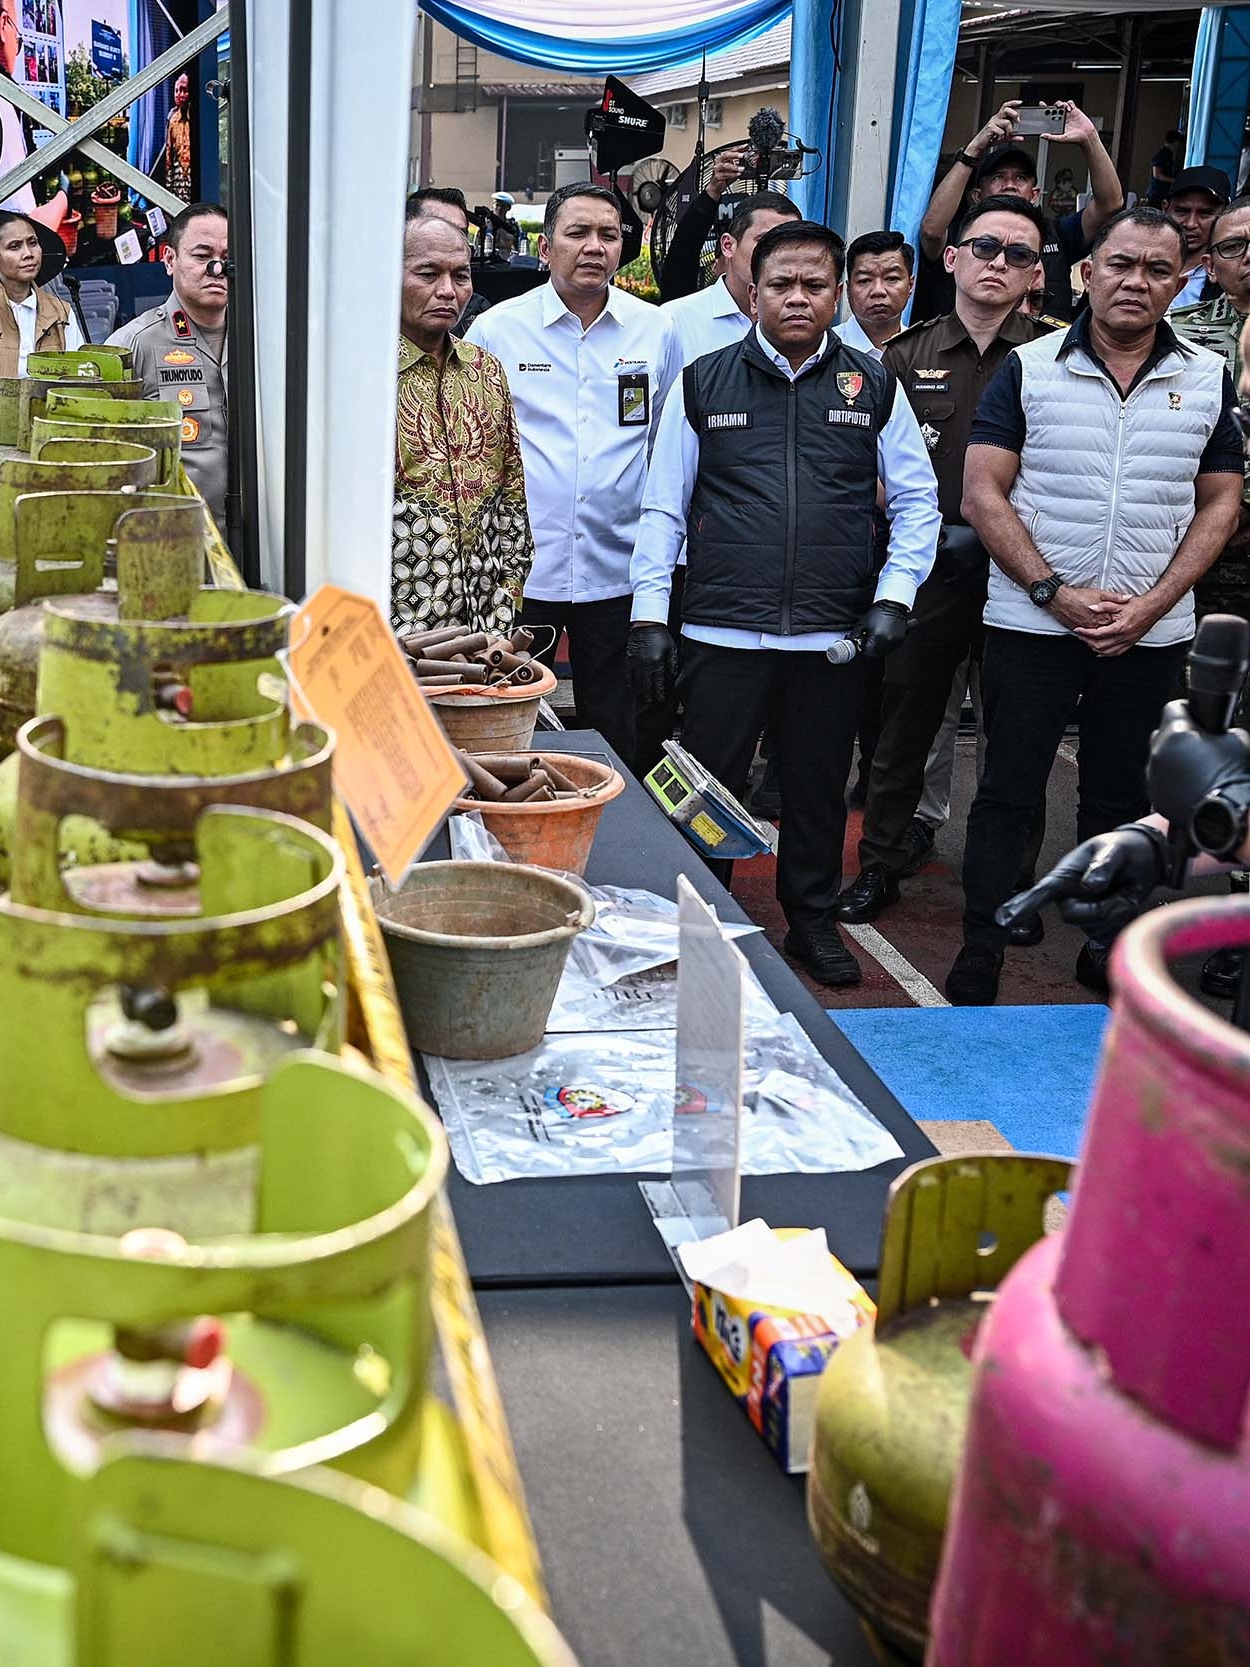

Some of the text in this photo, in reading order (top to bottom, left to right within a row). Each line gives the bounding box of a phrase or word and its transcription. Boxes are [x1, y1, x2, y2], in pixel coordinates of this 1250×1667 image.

[618, 115, 649, 128] SHURE
[160, 368, 203, 383] TRUNOYUDO
[707, 412, 748, 429] IRHAMNI
